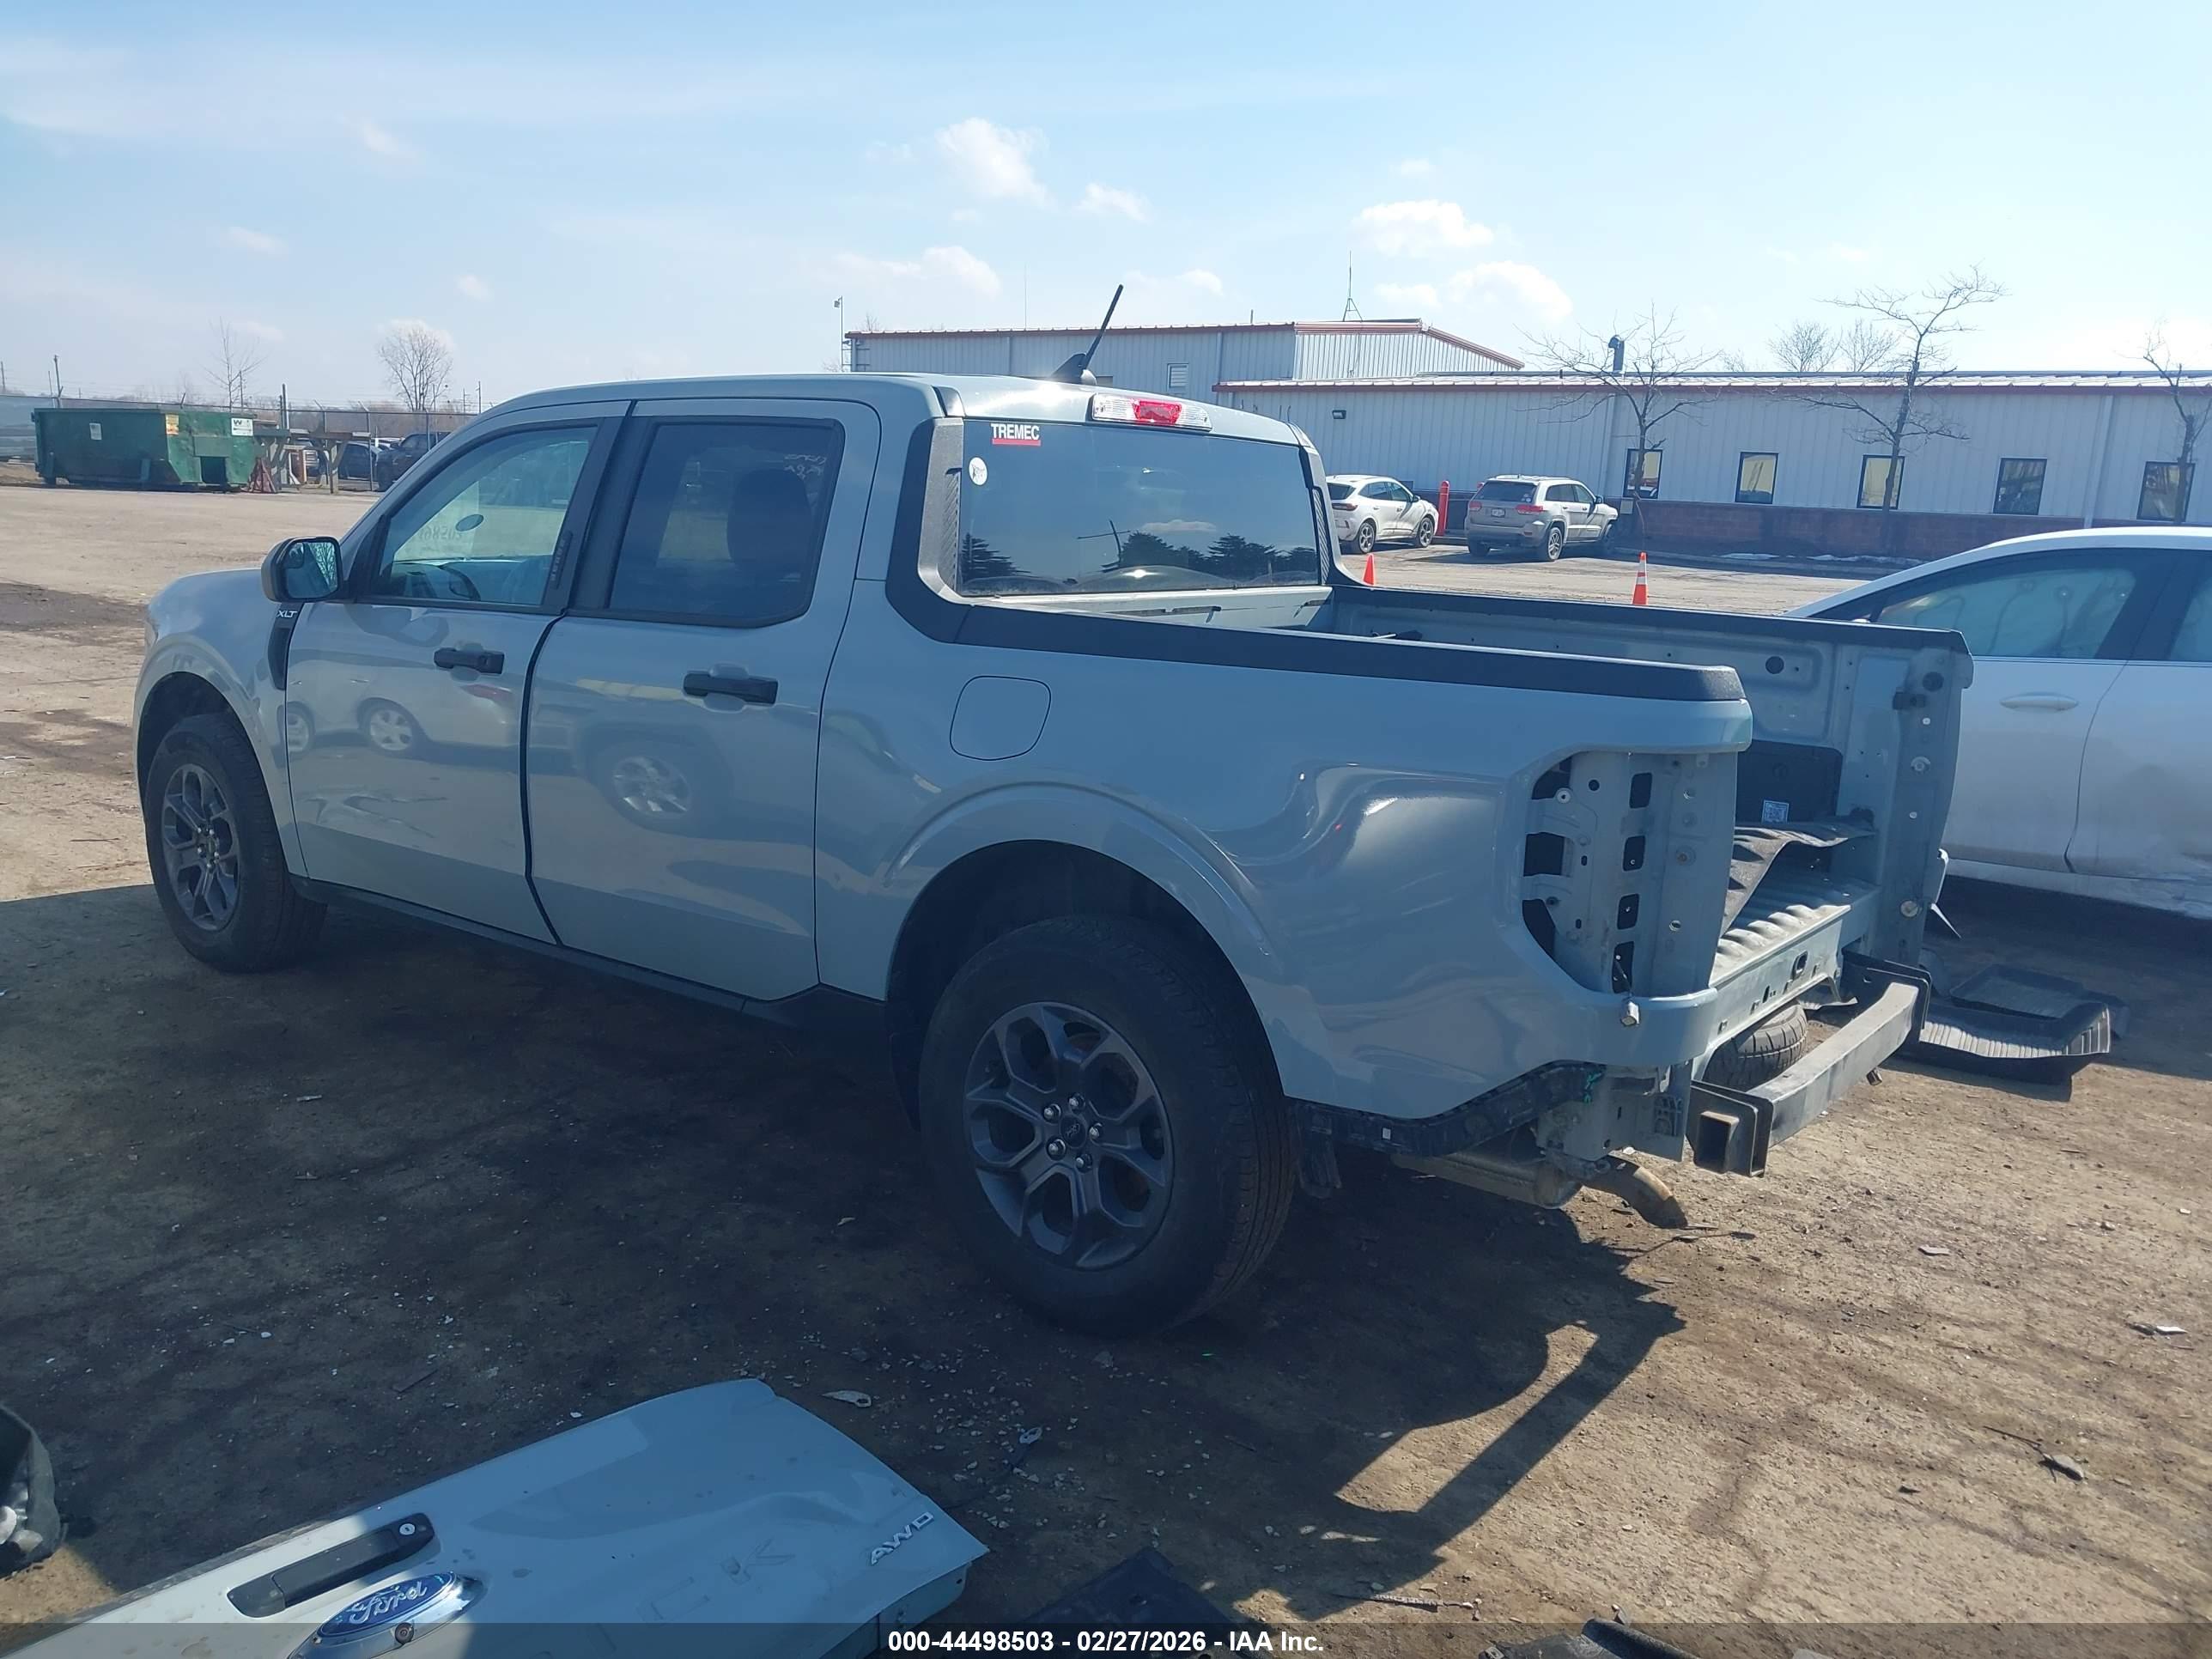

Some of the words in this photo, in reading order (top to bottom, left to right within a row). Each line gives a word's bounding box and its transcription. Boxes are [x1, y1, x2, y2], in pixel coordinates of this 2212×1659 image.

[990, 422, 1040, 441] TREMEC
[276, 610, 298, 618] XLT
[870, 1511, 934, 1565] AWD
[346, 1580, 428, 1624] Ford
